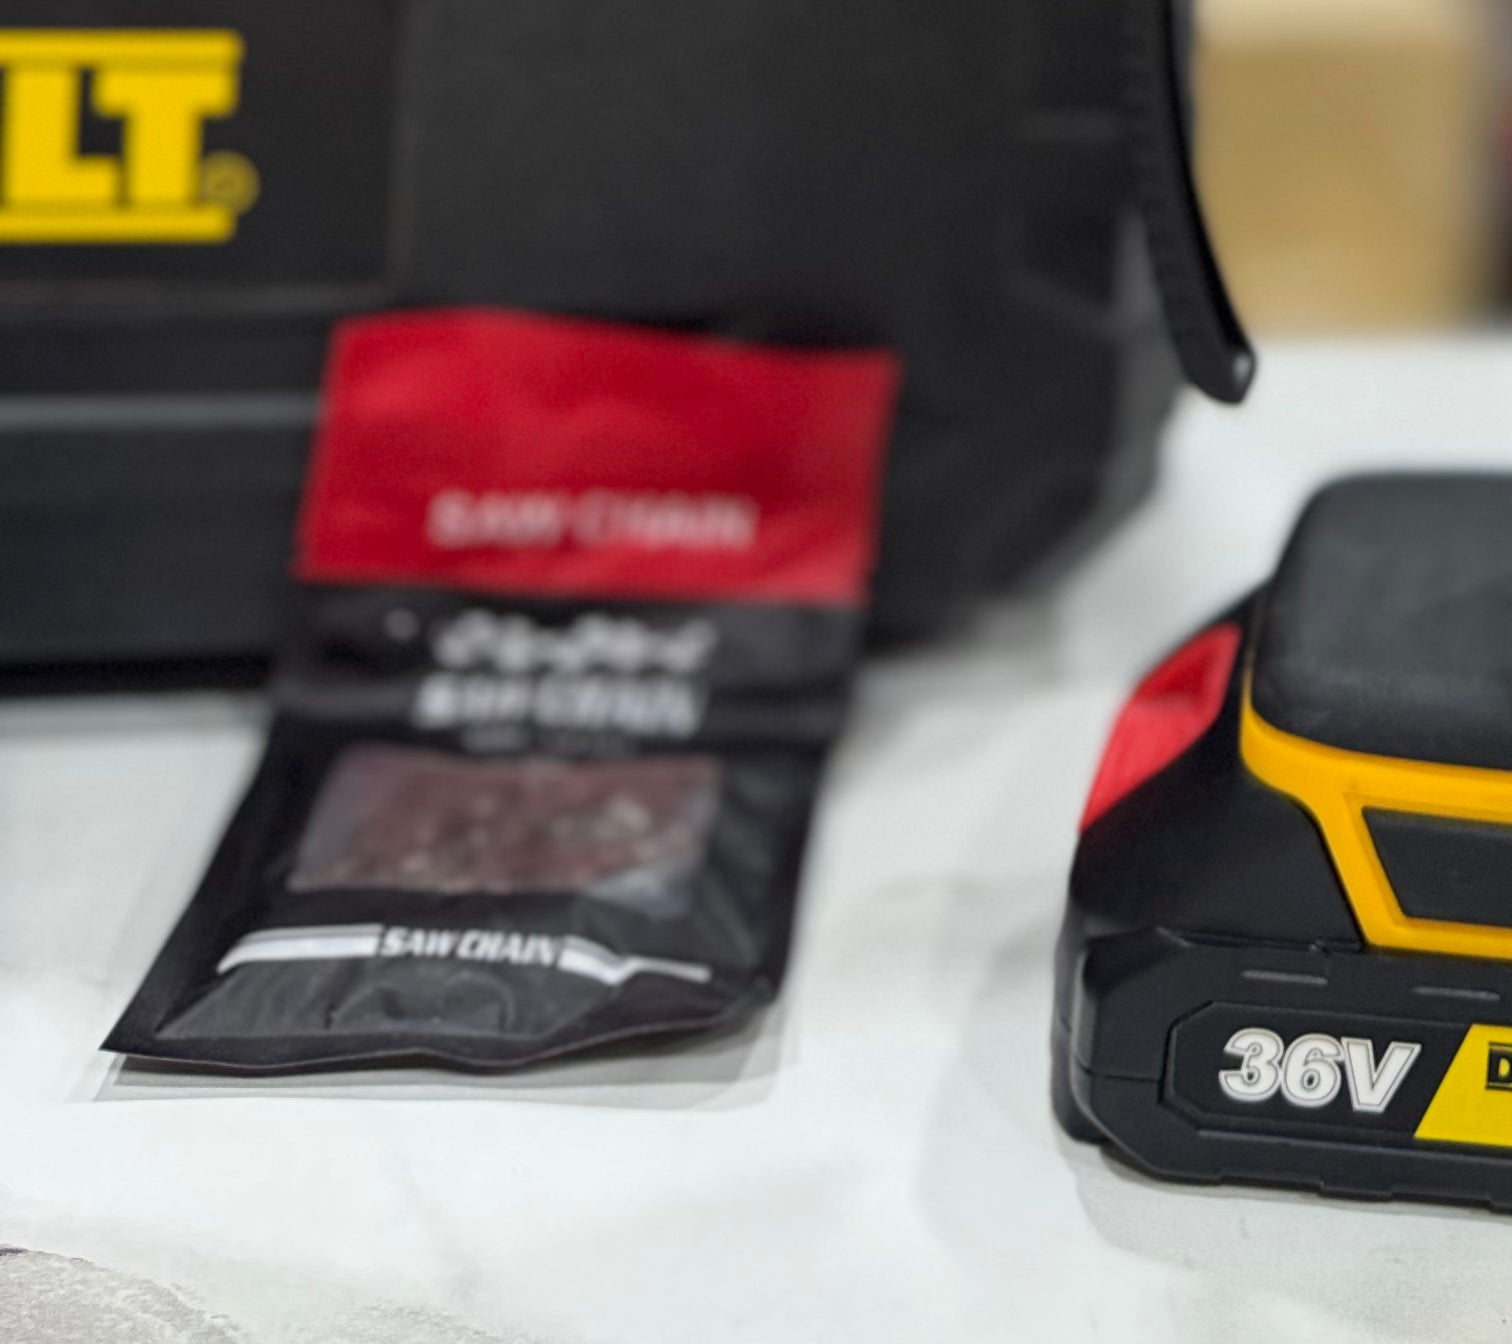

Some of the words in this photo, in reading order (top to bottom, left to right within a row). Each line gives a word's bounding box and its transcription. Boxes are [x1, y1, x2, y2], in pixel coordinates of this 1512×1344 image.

[380, 926, 458, 958] SAW
[456, 928, 557, 966] CHAIN
[1219, 1027, 1421, 1112] 36V
